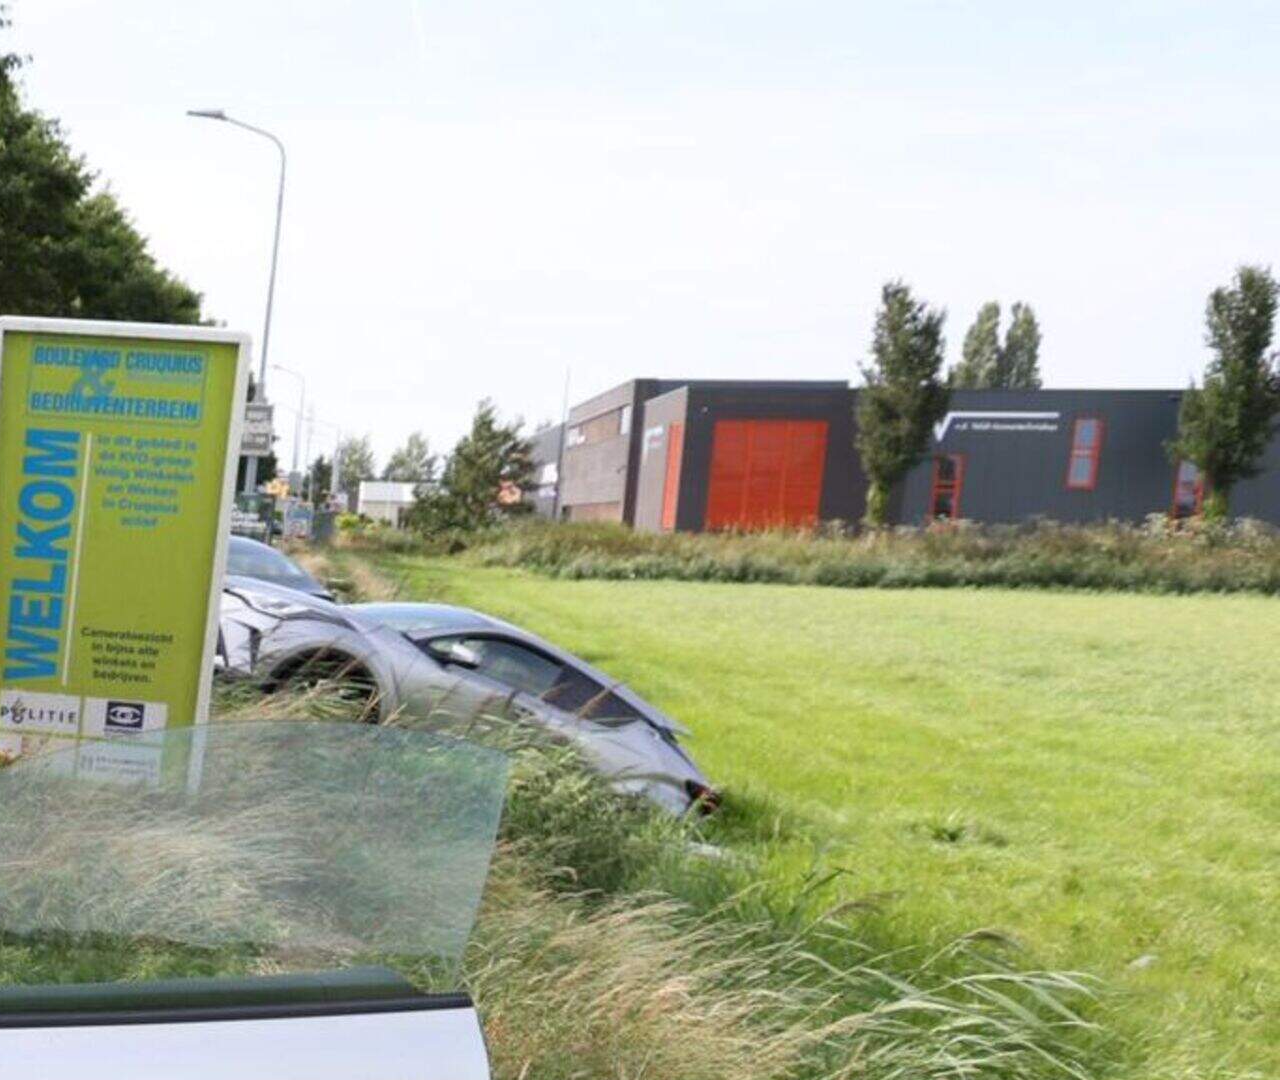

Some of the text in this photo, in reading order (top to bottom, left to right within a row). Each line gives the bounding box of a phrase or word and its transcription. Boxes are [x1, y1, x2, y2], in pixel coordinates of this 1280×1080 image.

[34, 345, 203, 373] BOULEVARD CRUQUIUS
[30, 392, 200, 421] BEDRIJVENTERREIN
[2, 428, 81, 680] WELKOM
[0, 701, 76, 724] POLITIE
